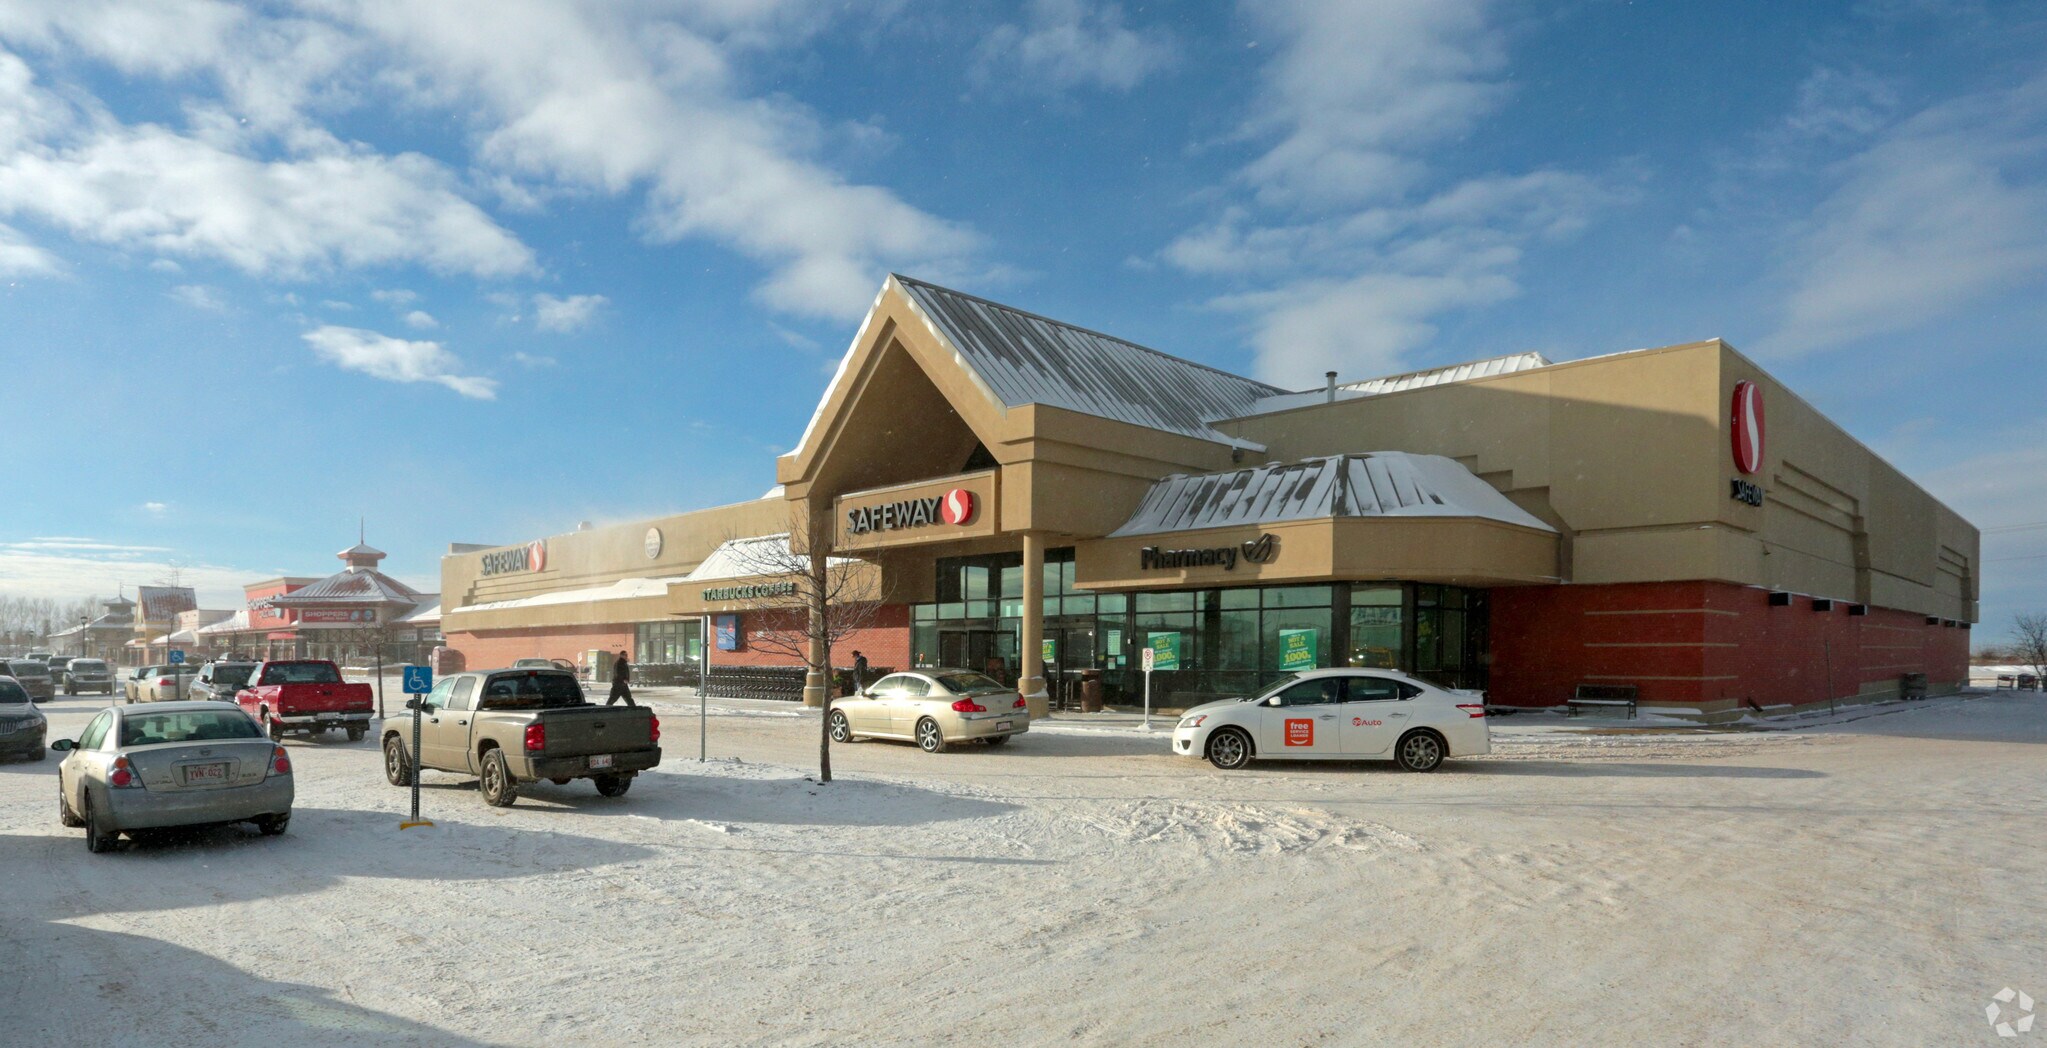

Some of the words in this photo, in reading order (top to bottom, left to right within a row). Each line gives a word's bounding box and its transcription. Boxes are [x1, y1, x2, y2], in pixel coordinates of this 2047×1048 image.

[846, 497, 943, 534] SAFEWAY
[481, 547, 530, 576] SAFEWAY
[1141, 546, 1237, 571] Pharmacy
[702, 585, 755, 601] STARBUCKS
[755, 582, 794, 598] COFFEE
[1290, 722, 1309, 730] free
